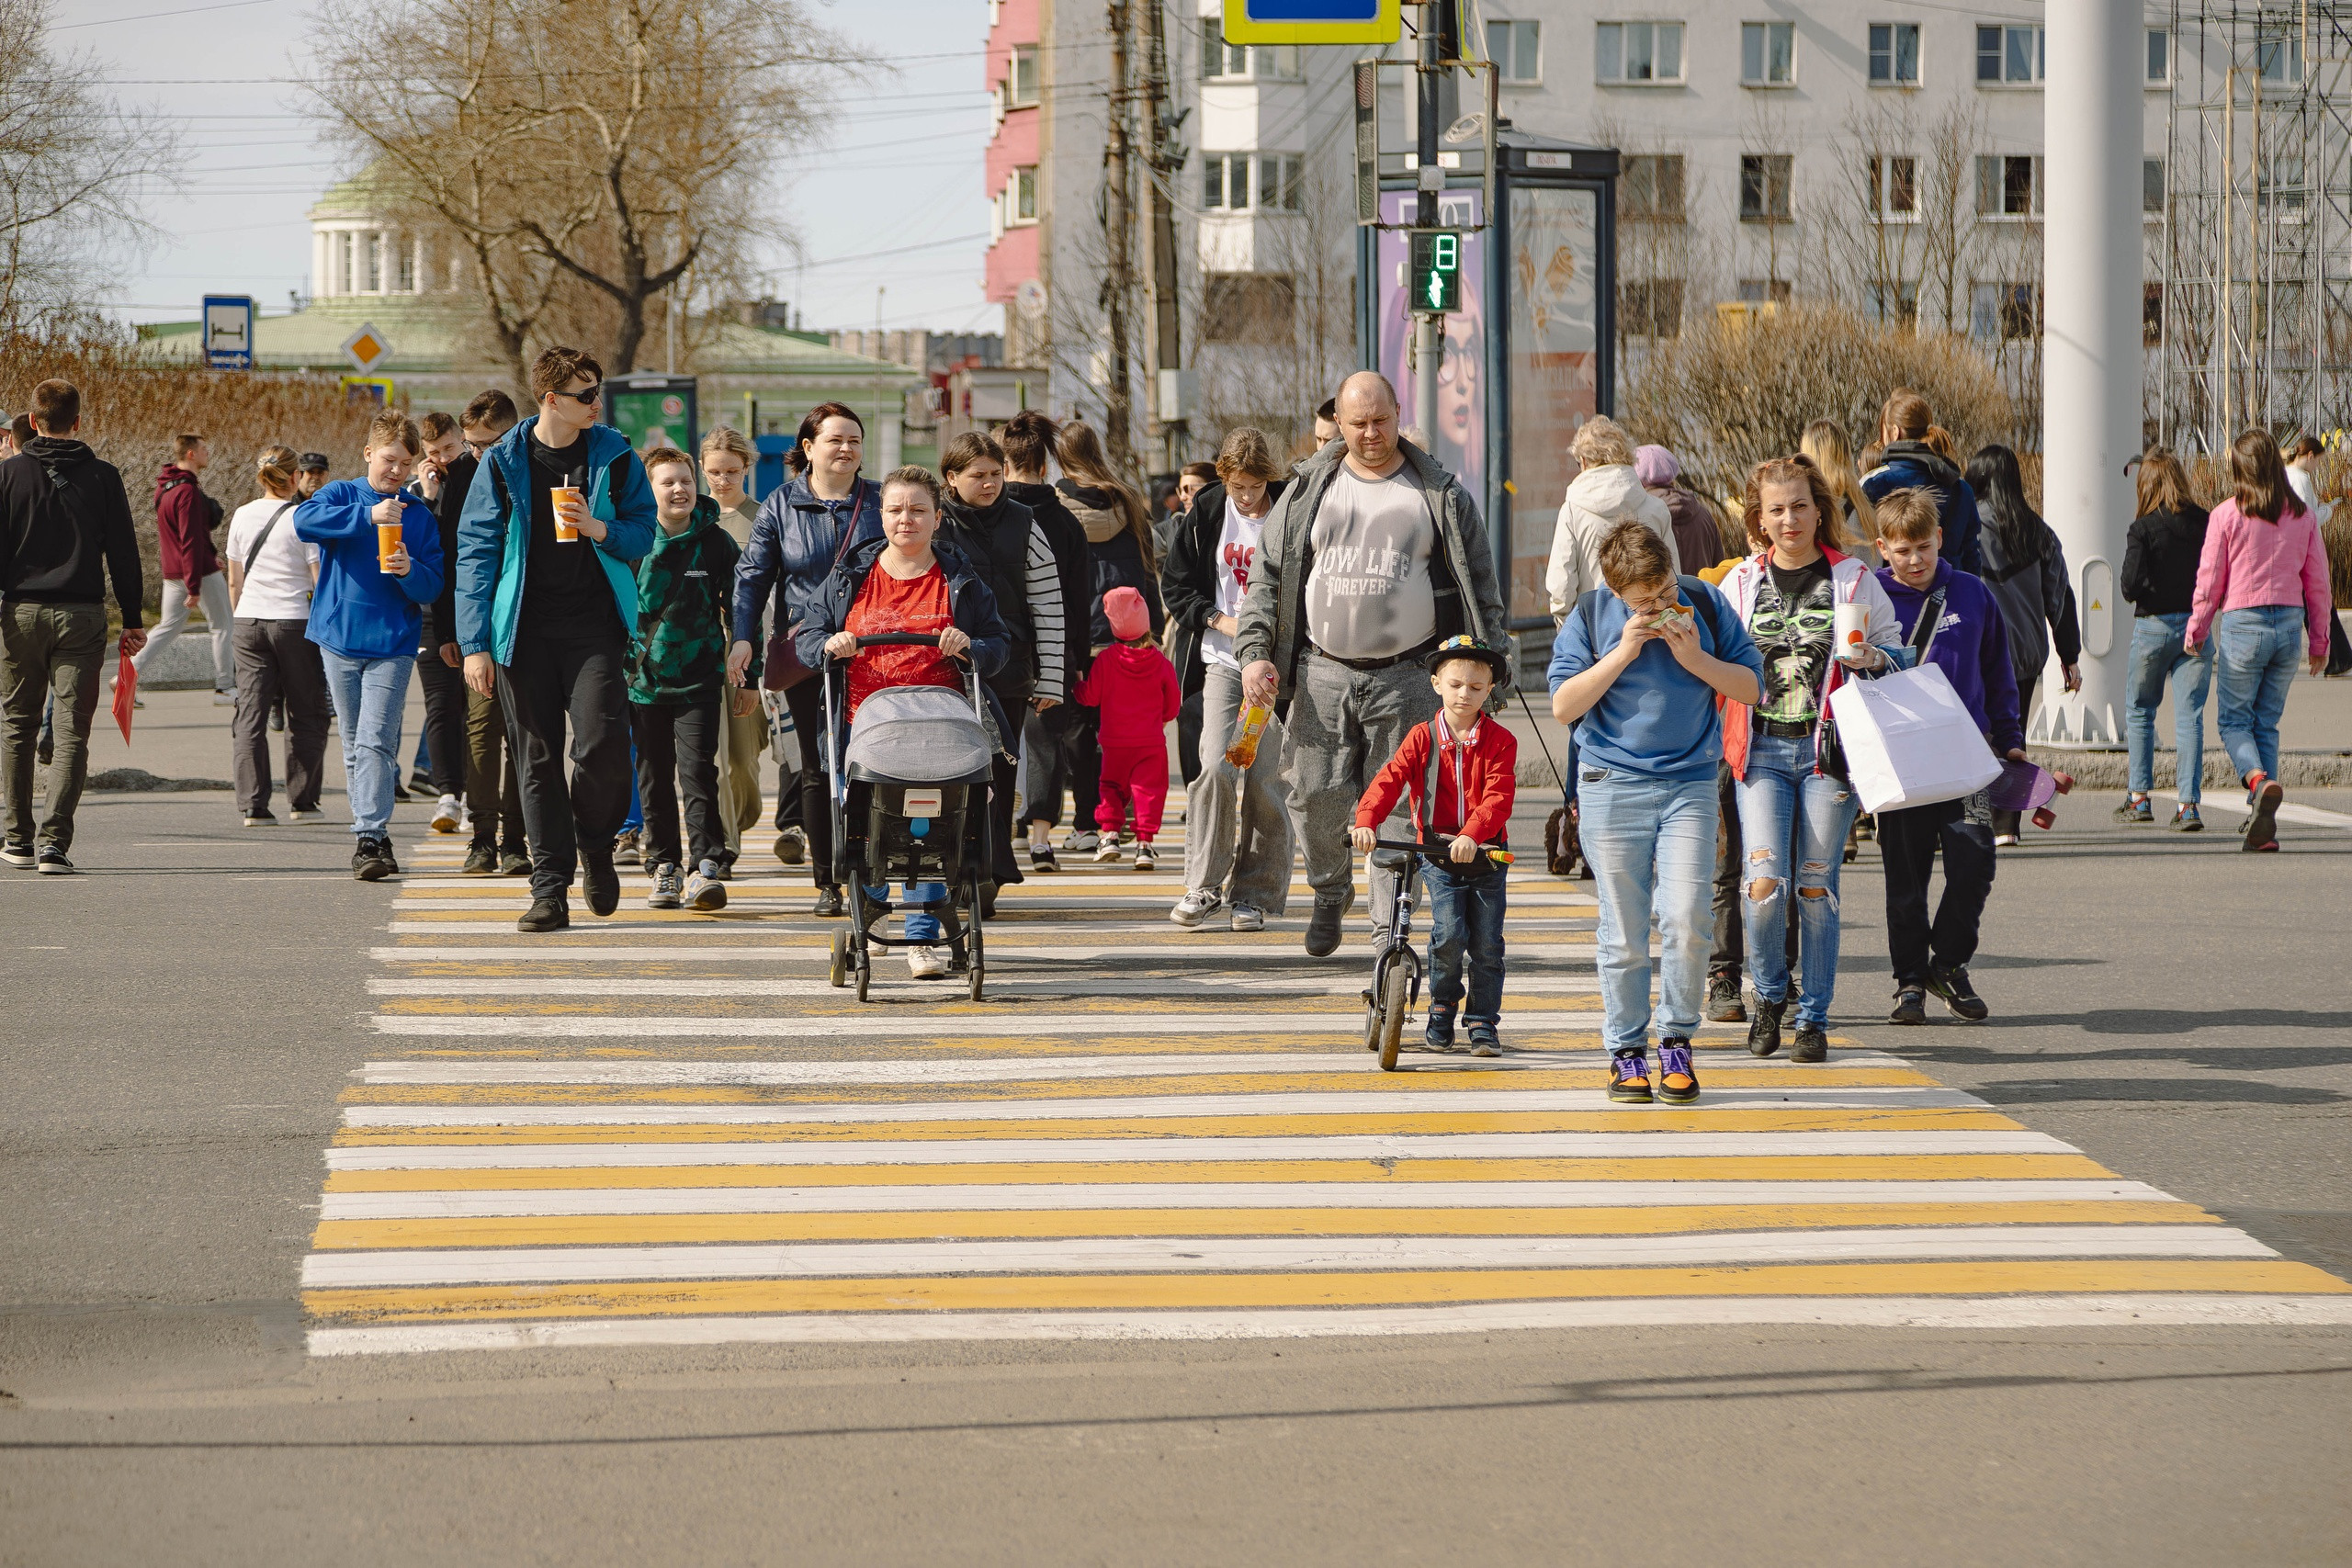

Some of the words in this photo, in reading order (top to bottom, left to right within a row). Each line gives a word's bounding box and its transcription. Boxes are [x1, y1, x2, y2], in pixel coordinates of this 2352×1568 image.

[1436, 234, 1457, 270] 8
[1316, 545, 1363, 577] LOW
[1364, 547, 1411, 581] LIFE
